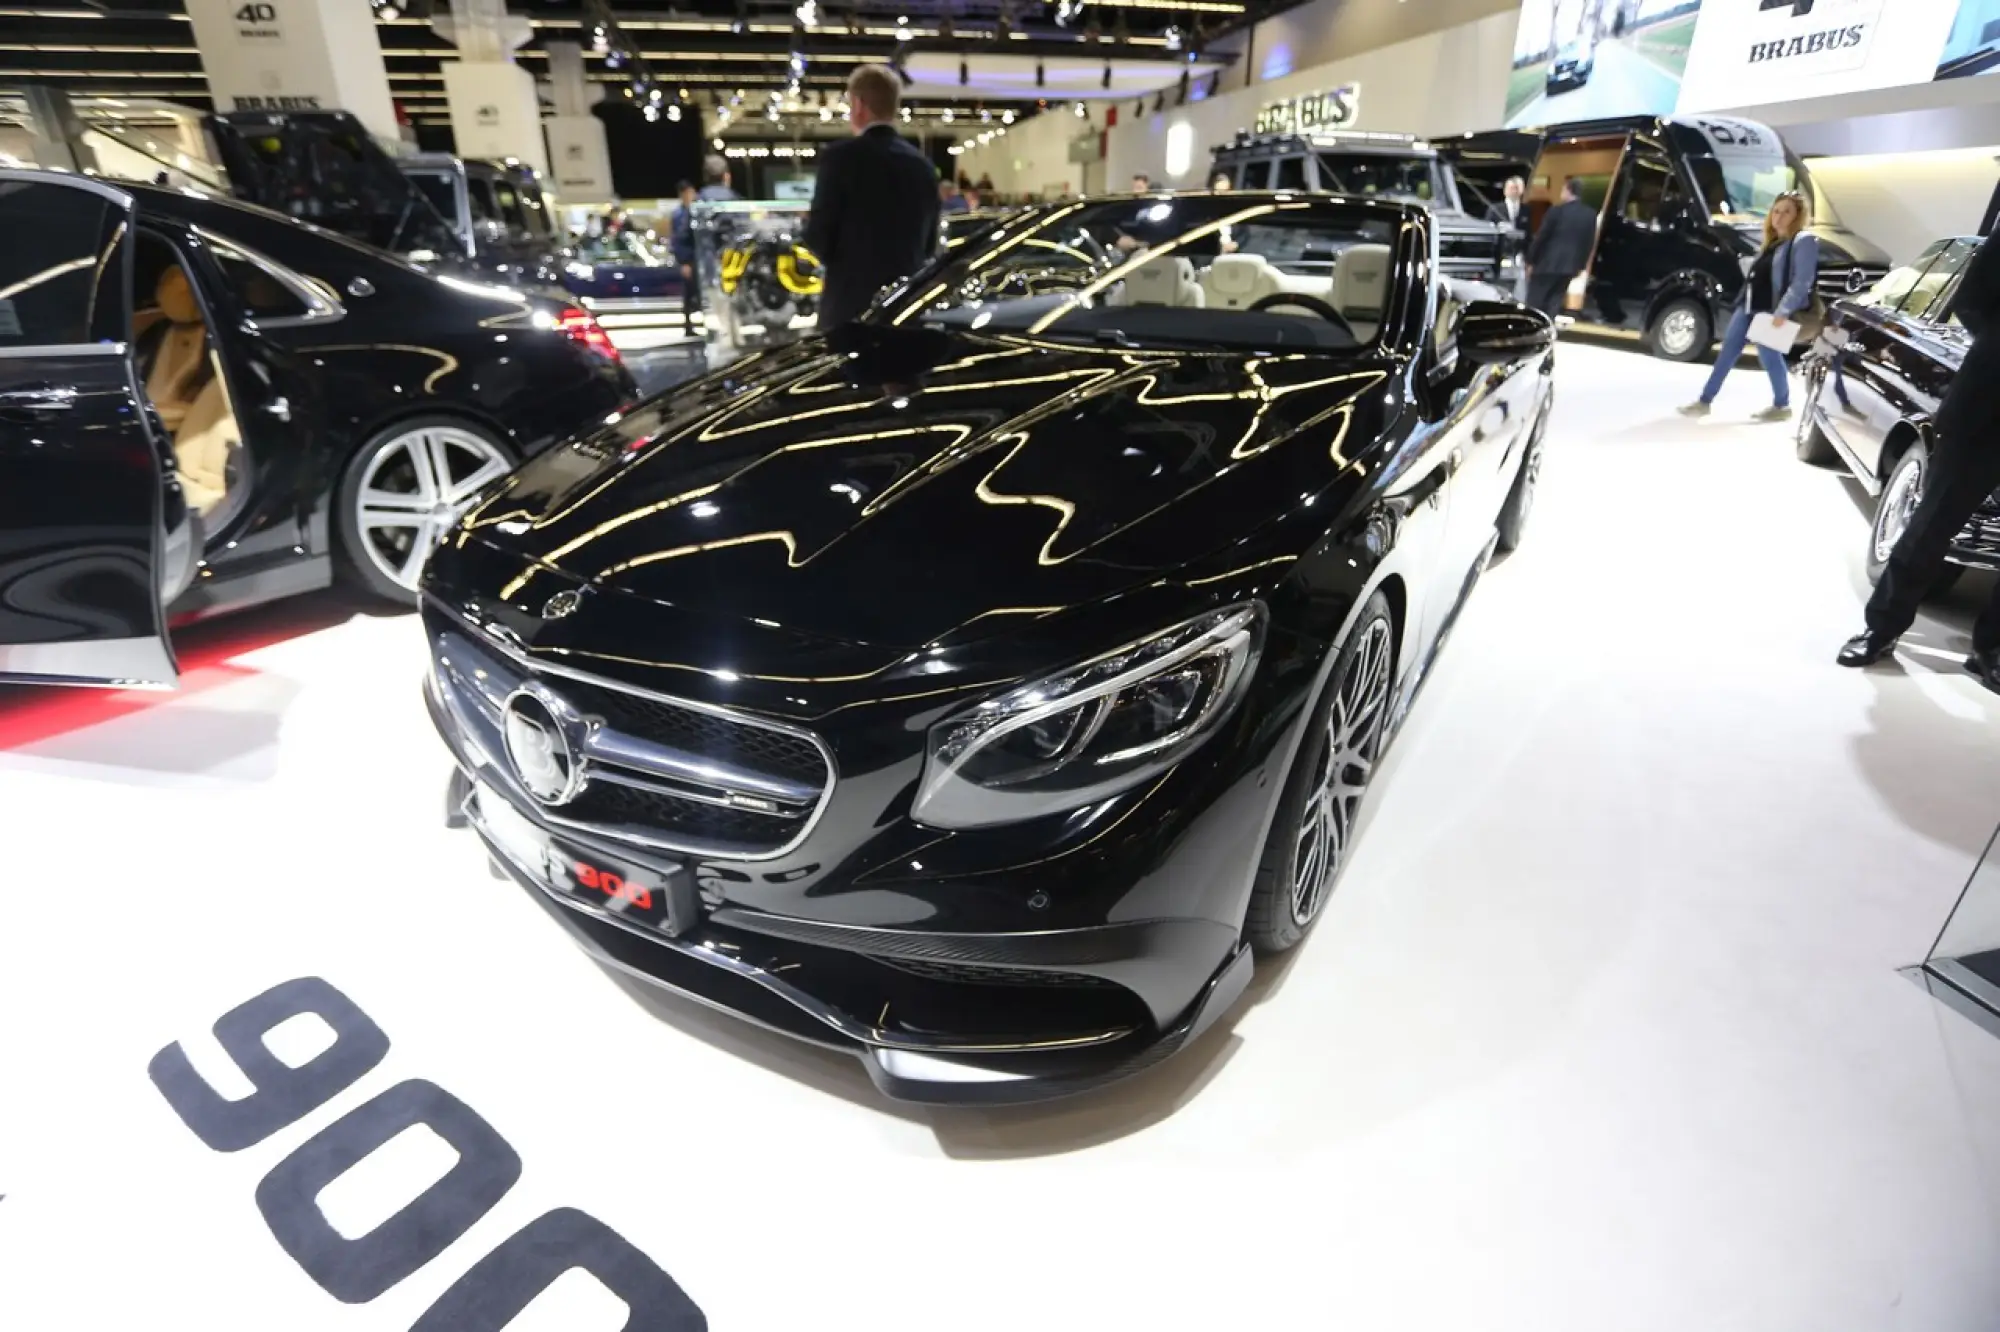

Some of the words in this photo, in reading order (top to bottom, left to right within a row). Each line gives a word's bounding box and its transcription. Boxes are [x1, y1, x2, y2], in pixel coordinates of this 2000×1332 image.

[236, 3, 276, 25] 40
[1749, 23, 1864, 63] BRABUS
[574, 861, 652, 909] 900
